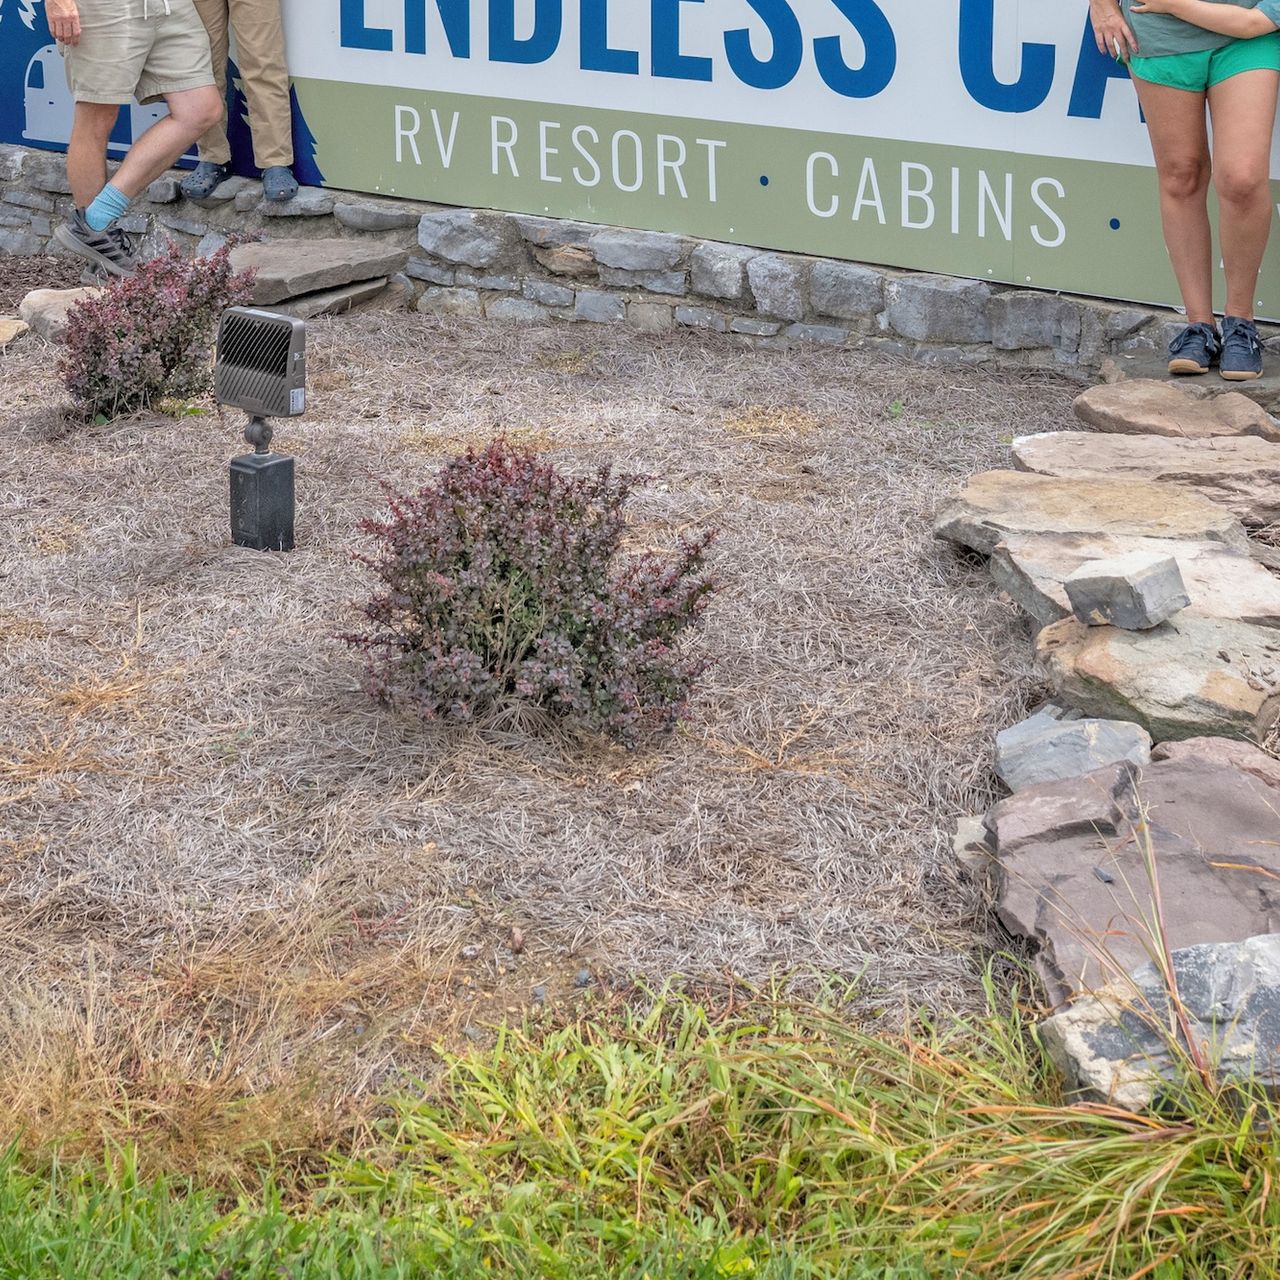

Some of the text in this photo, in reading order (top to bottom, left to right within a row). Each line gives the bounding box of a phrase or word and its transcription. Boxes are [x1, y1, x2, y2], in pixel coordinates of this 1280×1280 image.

[394, 104, 459, 169] RV
[491, 115, 727, 203] RESORT
[806, 151, 1067, 248] CABINS
